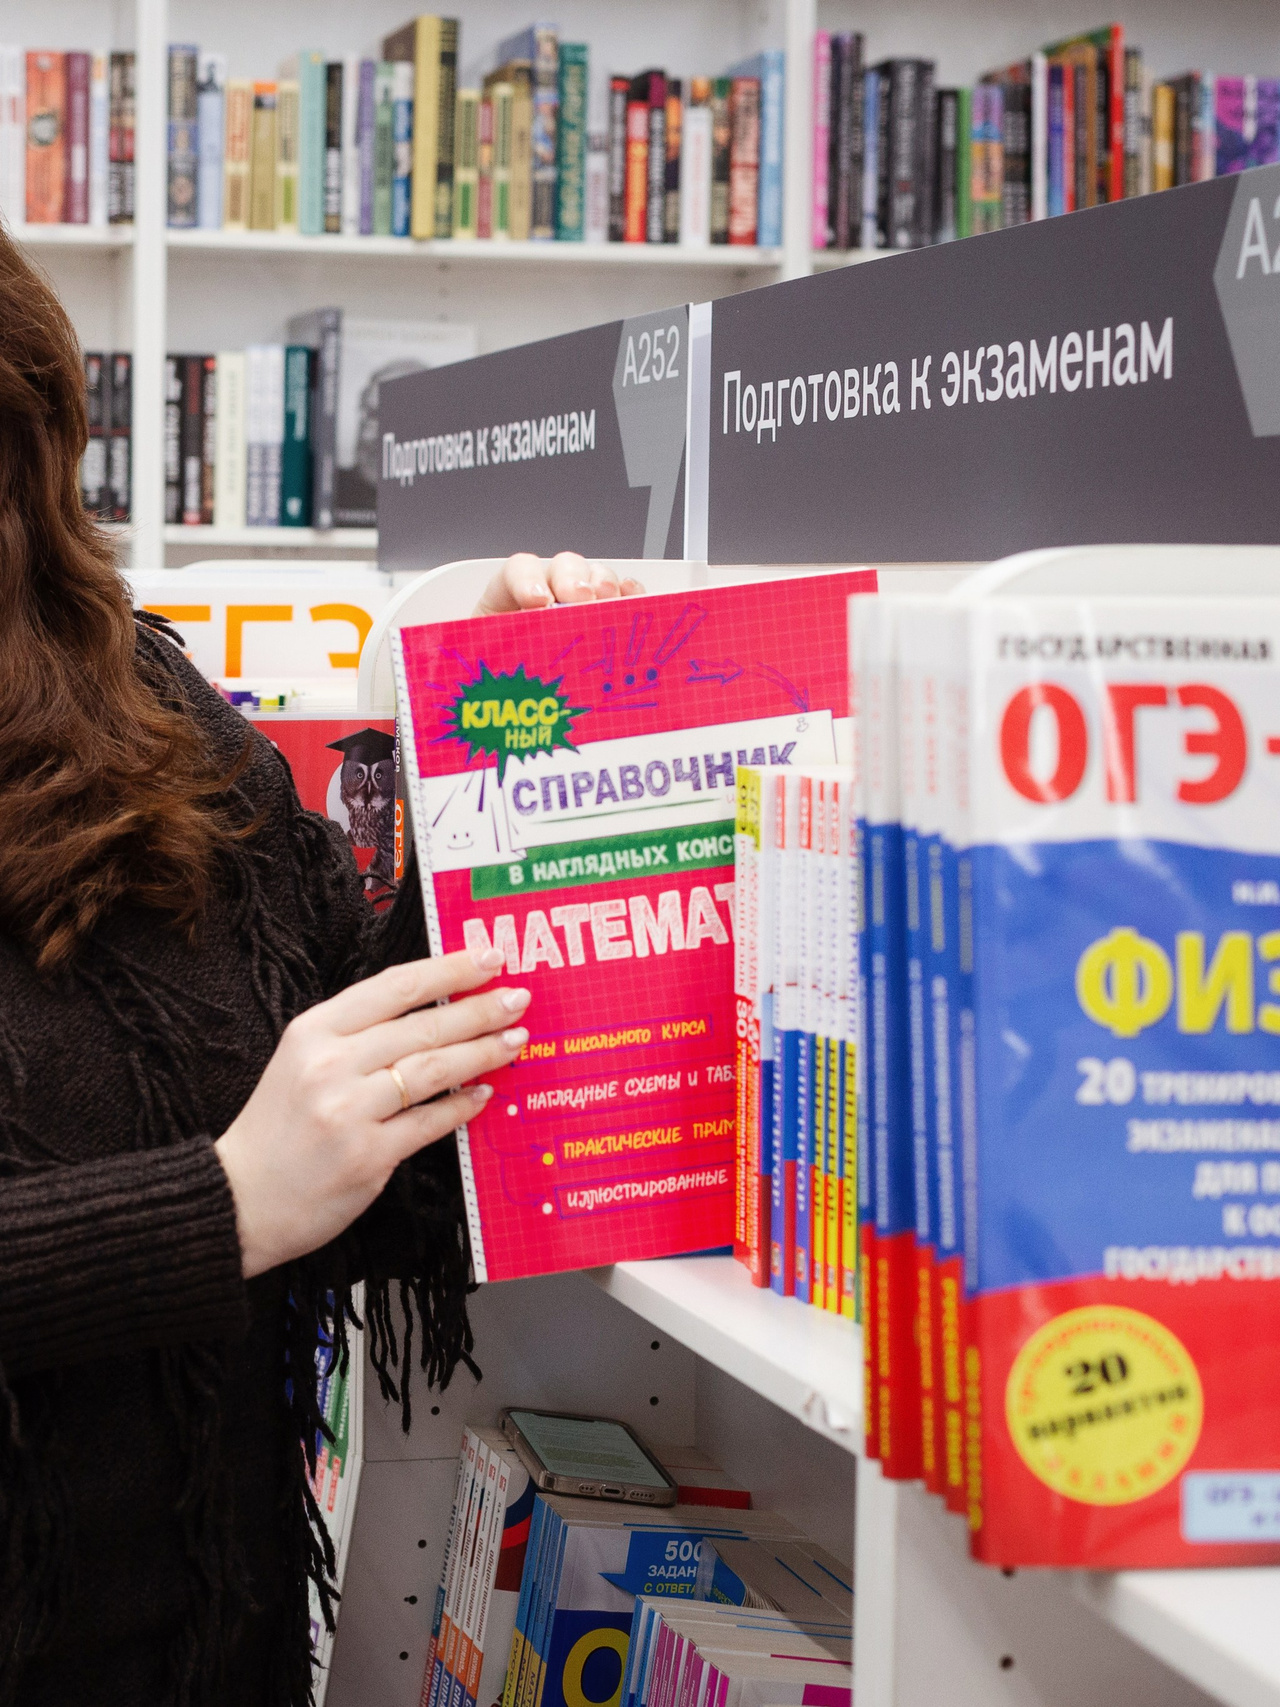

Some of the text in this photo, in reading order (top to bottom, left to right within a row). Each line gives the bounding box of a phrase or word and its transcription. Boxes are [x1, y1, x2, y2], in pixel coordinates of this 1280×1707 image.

[722, 317, 1174, 443] Подготовка к экзаменам
[382, 409, 596, 486] Подготовка к экзаменам
[141, 603, 373, 678] ГЭ
[998, 634, 1272, 661] ГОСУДАРСТВЕННАЯ
[462, 697, 572, 729] КЛАСС-
[505, 725, 552, 750] НЫЙ
[511, 741, 798, 816] СПРАВОЧНИК
[394, 803, 403, 868] ОГЭ
[509, 833, 736, 886] В НАГЛЯДНЫХ КОНС
[520, 1019, 706, 1060] ЕМЫ ШКОЛЬНОГО КУРСА
[527, 1082, 618, 1111] НАГЛЯДНЫЕ
[624, 1071, 681, 1095] СХЕМЫ
[1075, 1057, 1136, 1106] 20
[563, 1126, 683, 1159] ПРАКТИЧЕСКИЕ
[567, 1169, 729, 1210] ИЛЛЮСТРИРОВАННЫЕ
[1065, 1353, 1128, 1395] 20
